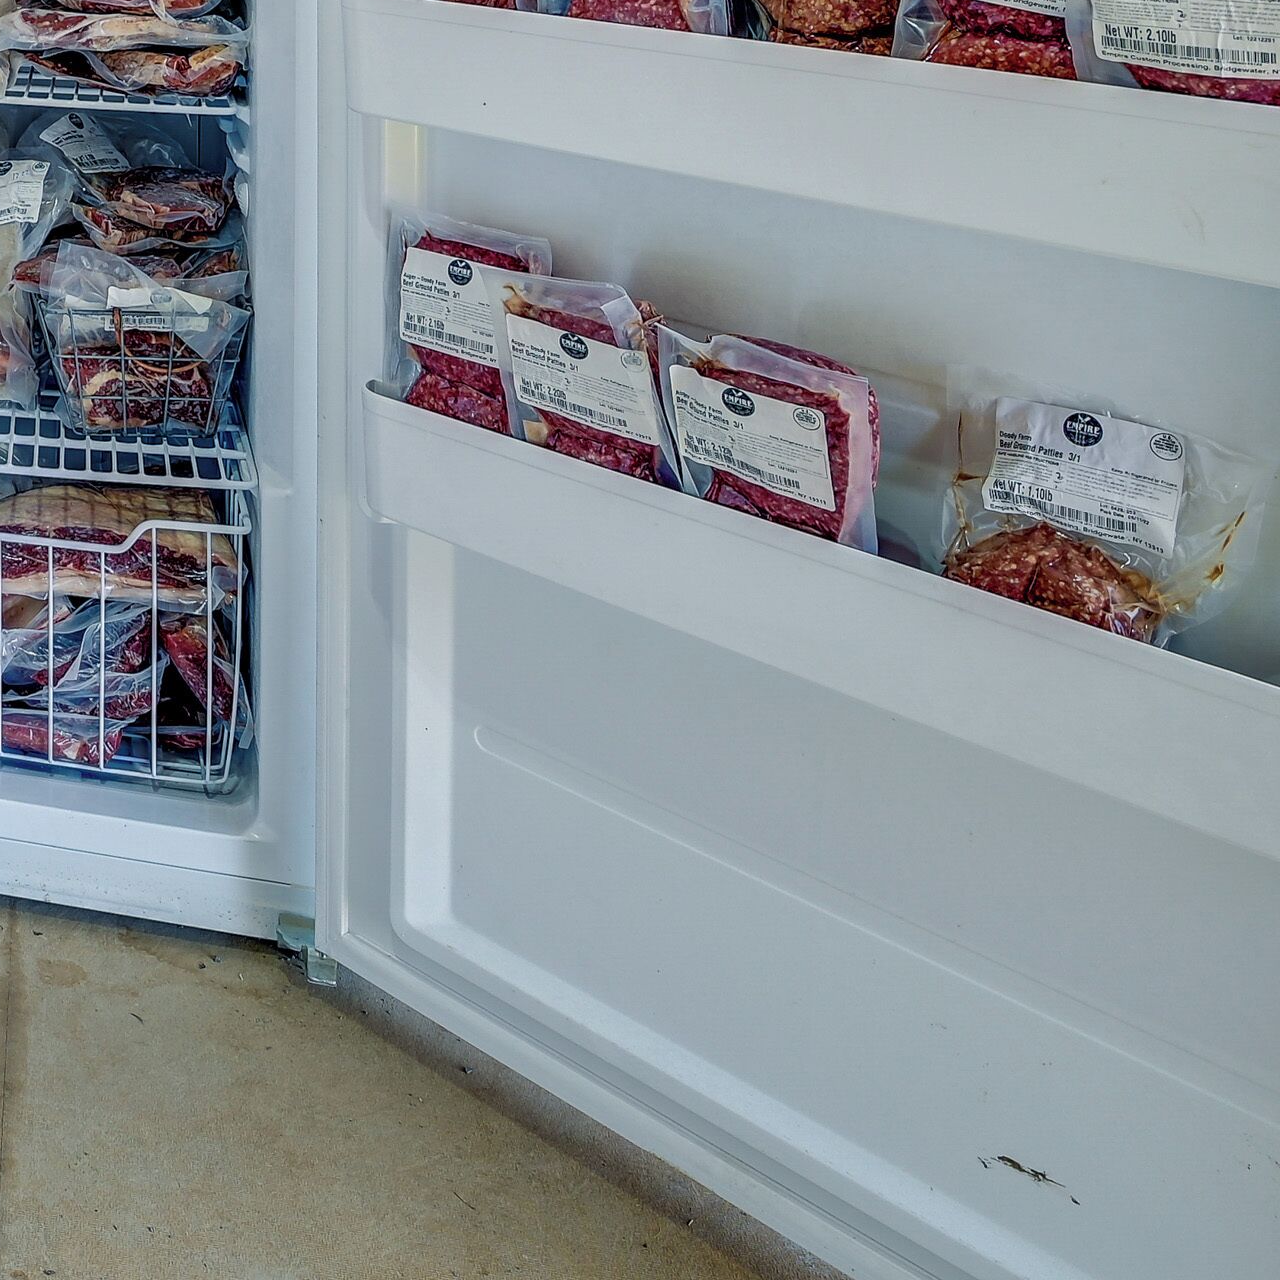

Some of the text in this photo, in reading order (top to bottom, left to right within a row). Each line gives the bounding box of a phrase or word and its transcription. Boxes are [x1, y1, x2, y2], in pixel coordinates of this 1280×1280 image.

[1105, 23, 1176, 44] Net WT: 2.10lb
[1130, 54, 1161, 64] Custom
[1013, 442, 1080, 463] Ground Patties 3/1
[1028, 485, 1053, 501] 1.10lb
